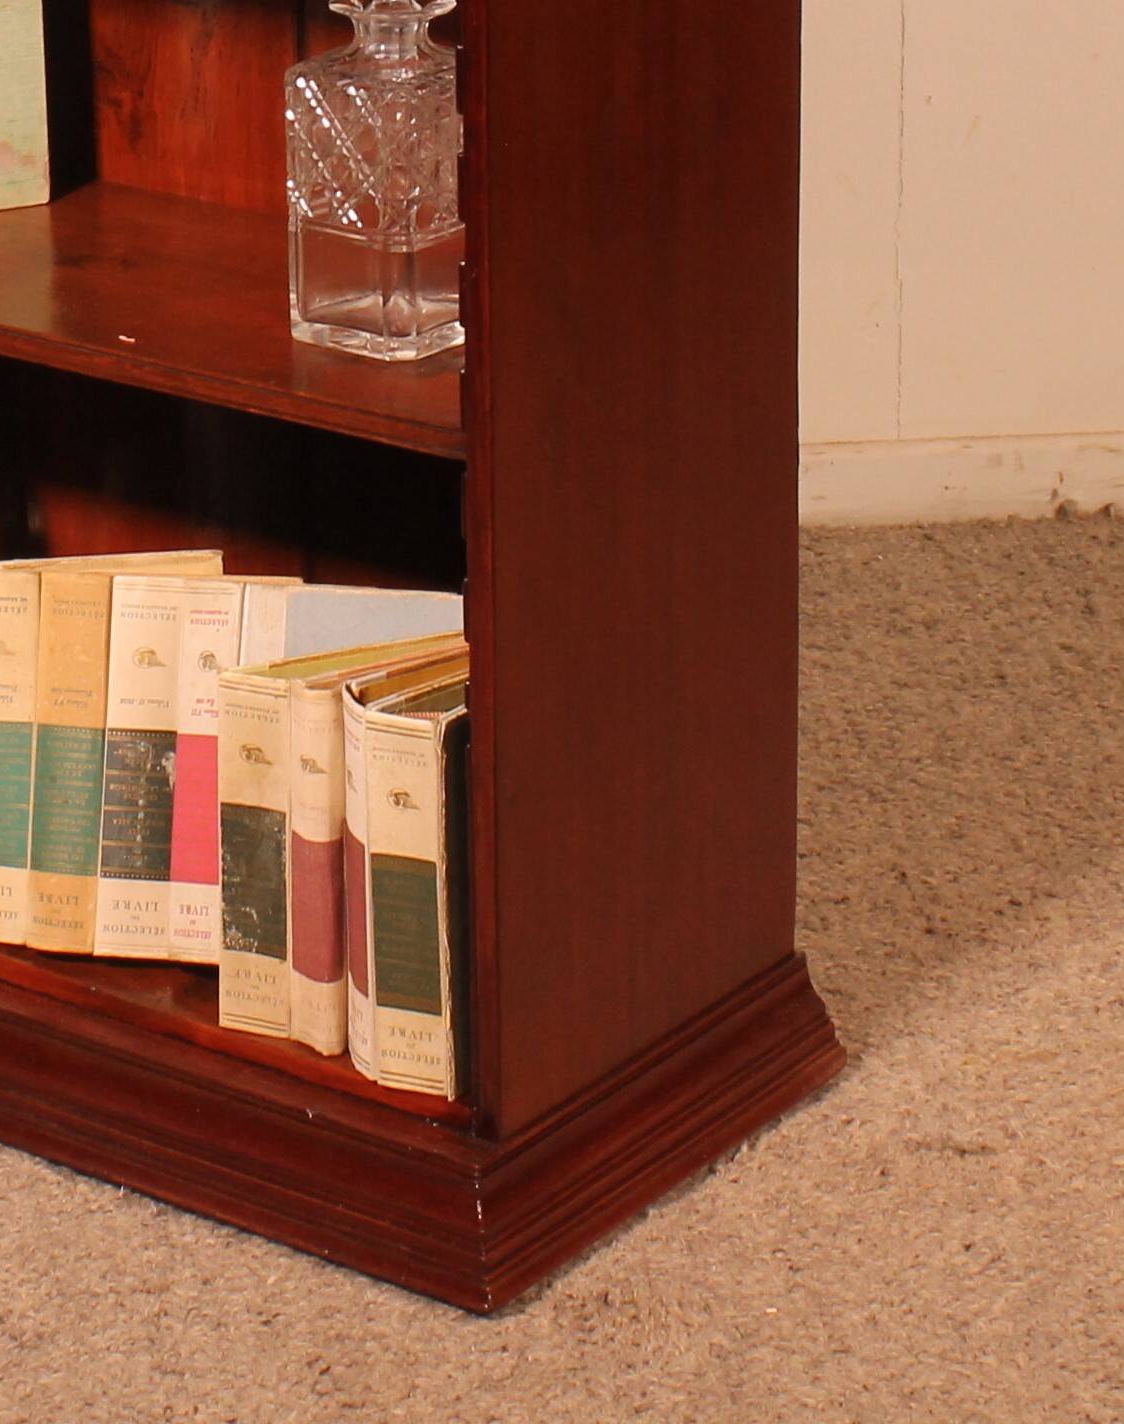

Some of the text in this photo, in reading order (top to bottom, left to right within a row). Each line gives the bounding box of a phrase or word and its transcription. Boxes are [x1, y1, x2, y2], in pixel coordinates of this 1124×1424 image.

[36, 892, 79, 906] LIVRE
[111, 899, 159, 913] LIVRE
[179, 903, 209, 917] LIVRE
[387, 1026, 433, 1043] LIVRE
